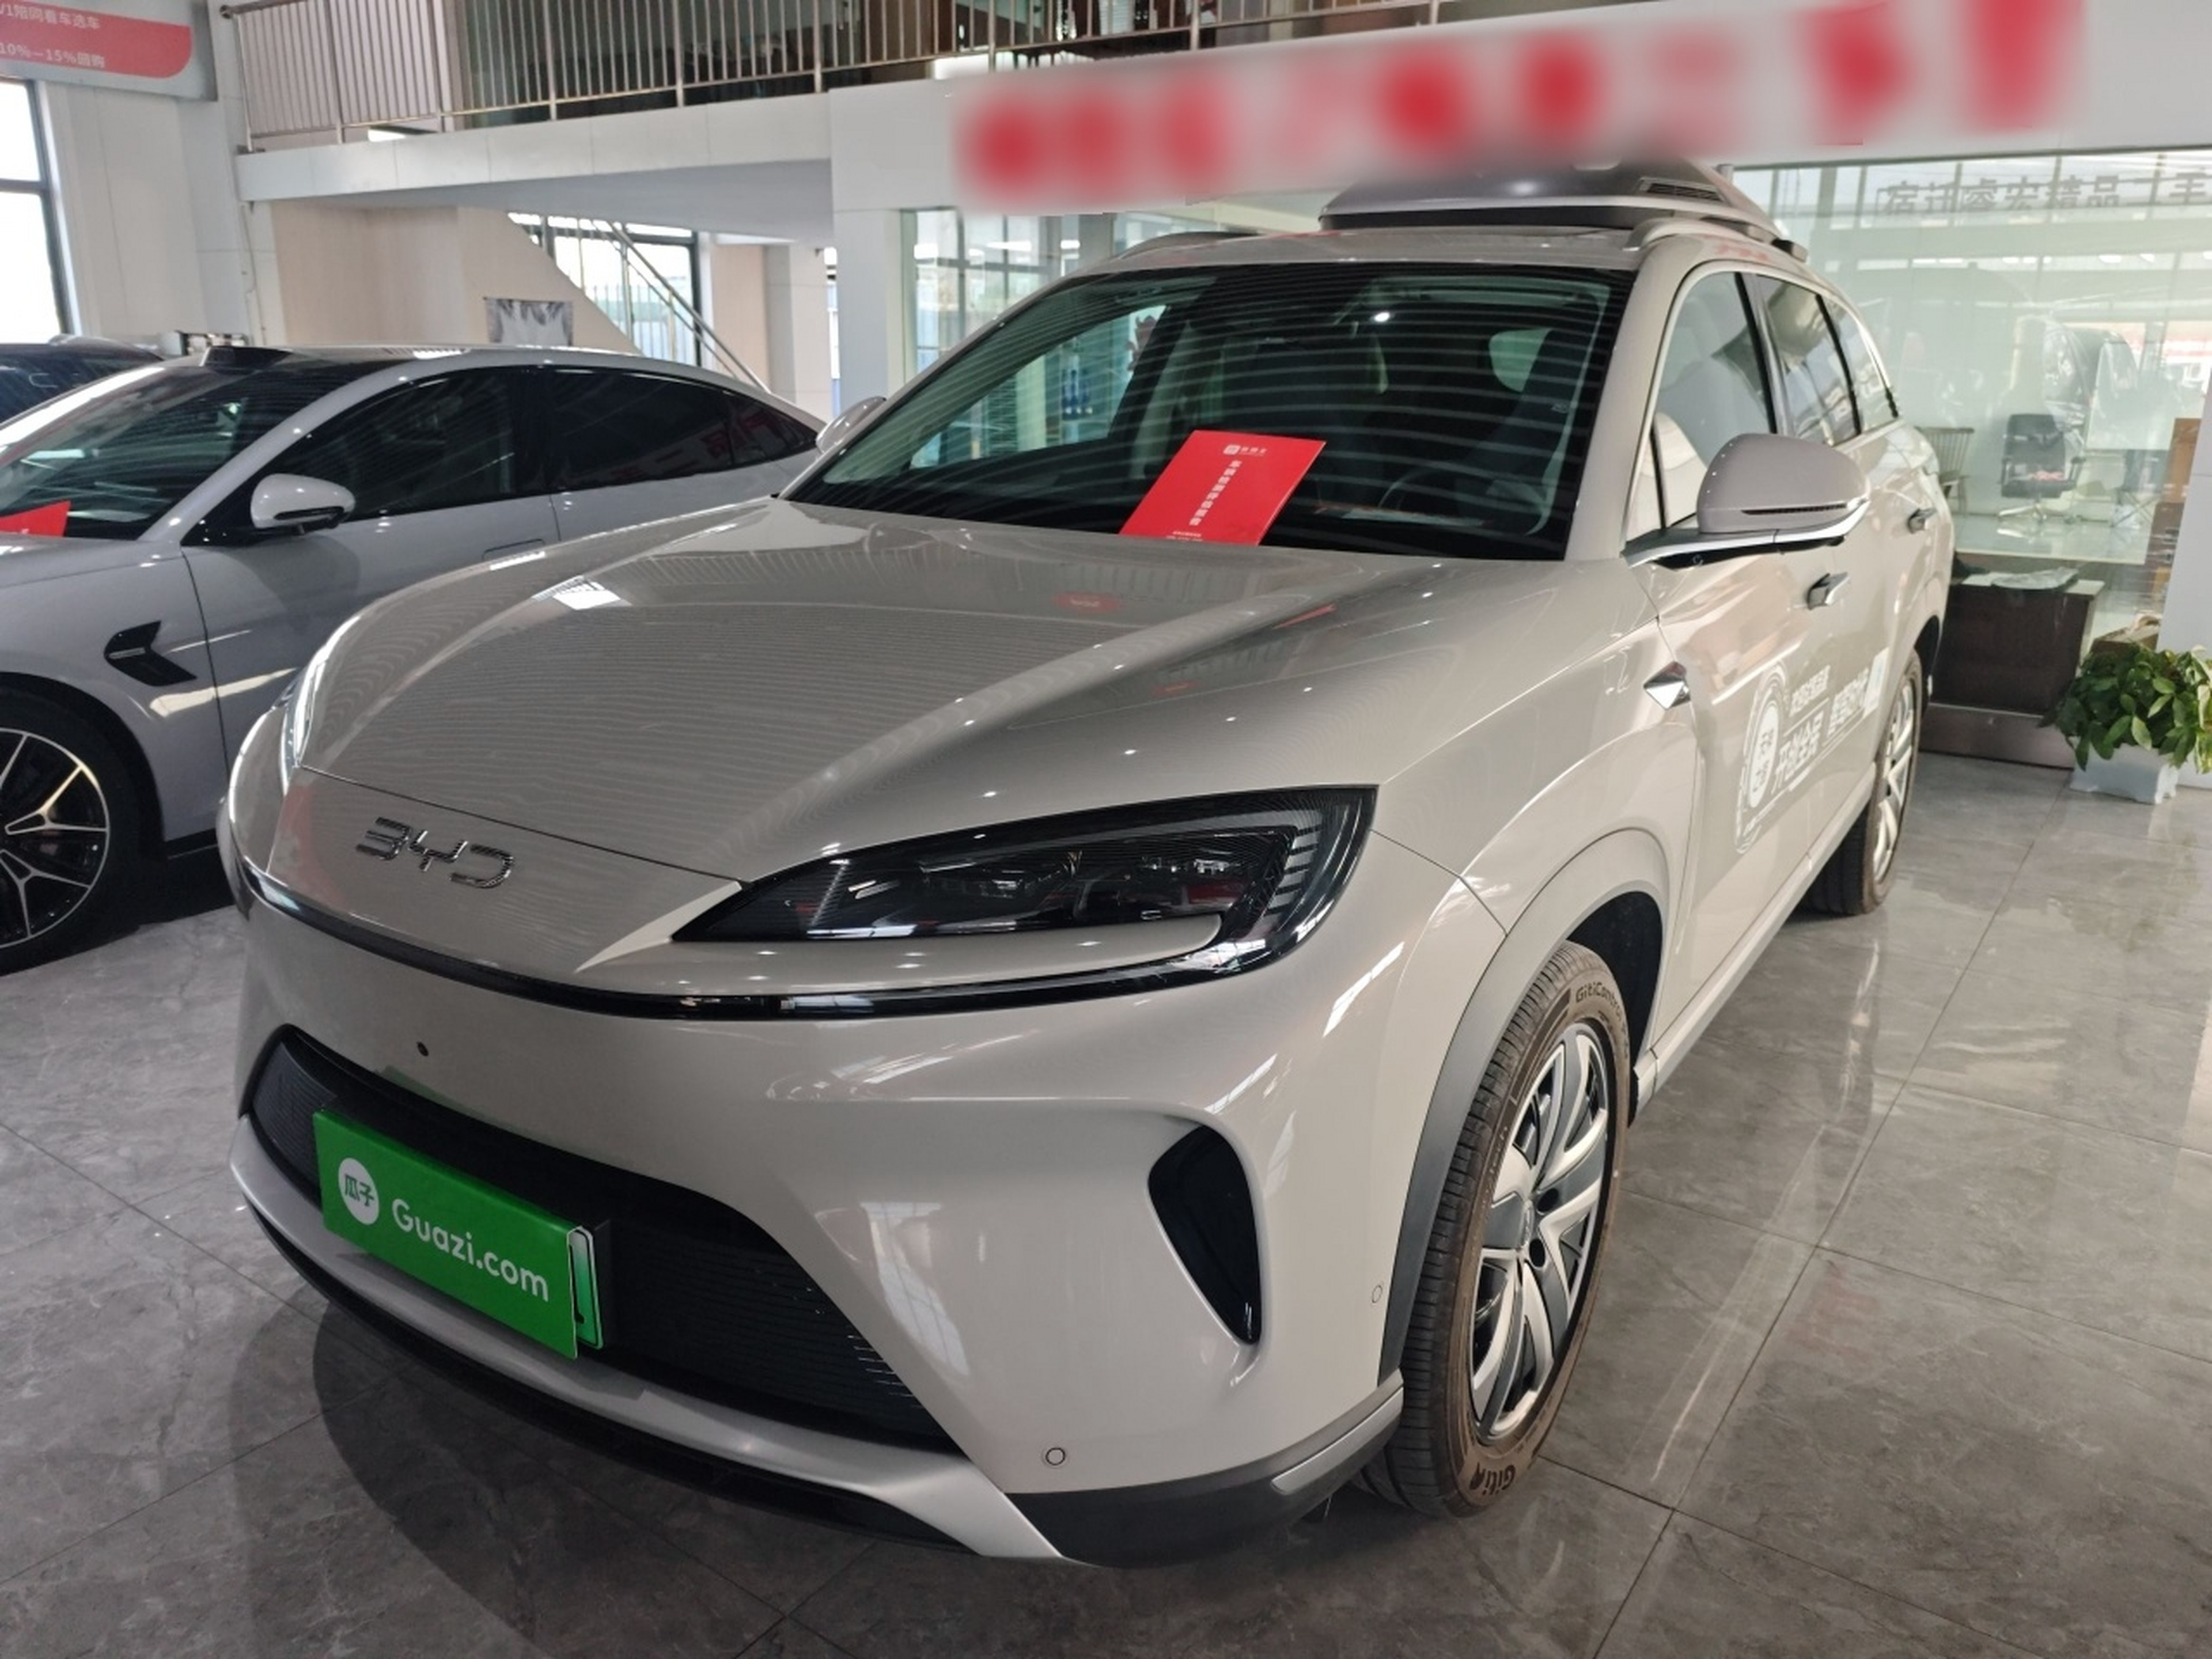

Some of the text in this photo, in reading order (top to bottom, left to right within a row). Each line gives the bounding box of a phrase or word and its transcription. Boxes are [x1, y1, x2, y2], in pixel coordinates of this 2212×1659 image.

[355, 816, 514, 889] BYD
[344, 1173, 375, 1207] 瓜子
[391, 1198, 549, 1302] Guazi.com
[1482, 1464, 1516, 1496] Giti
